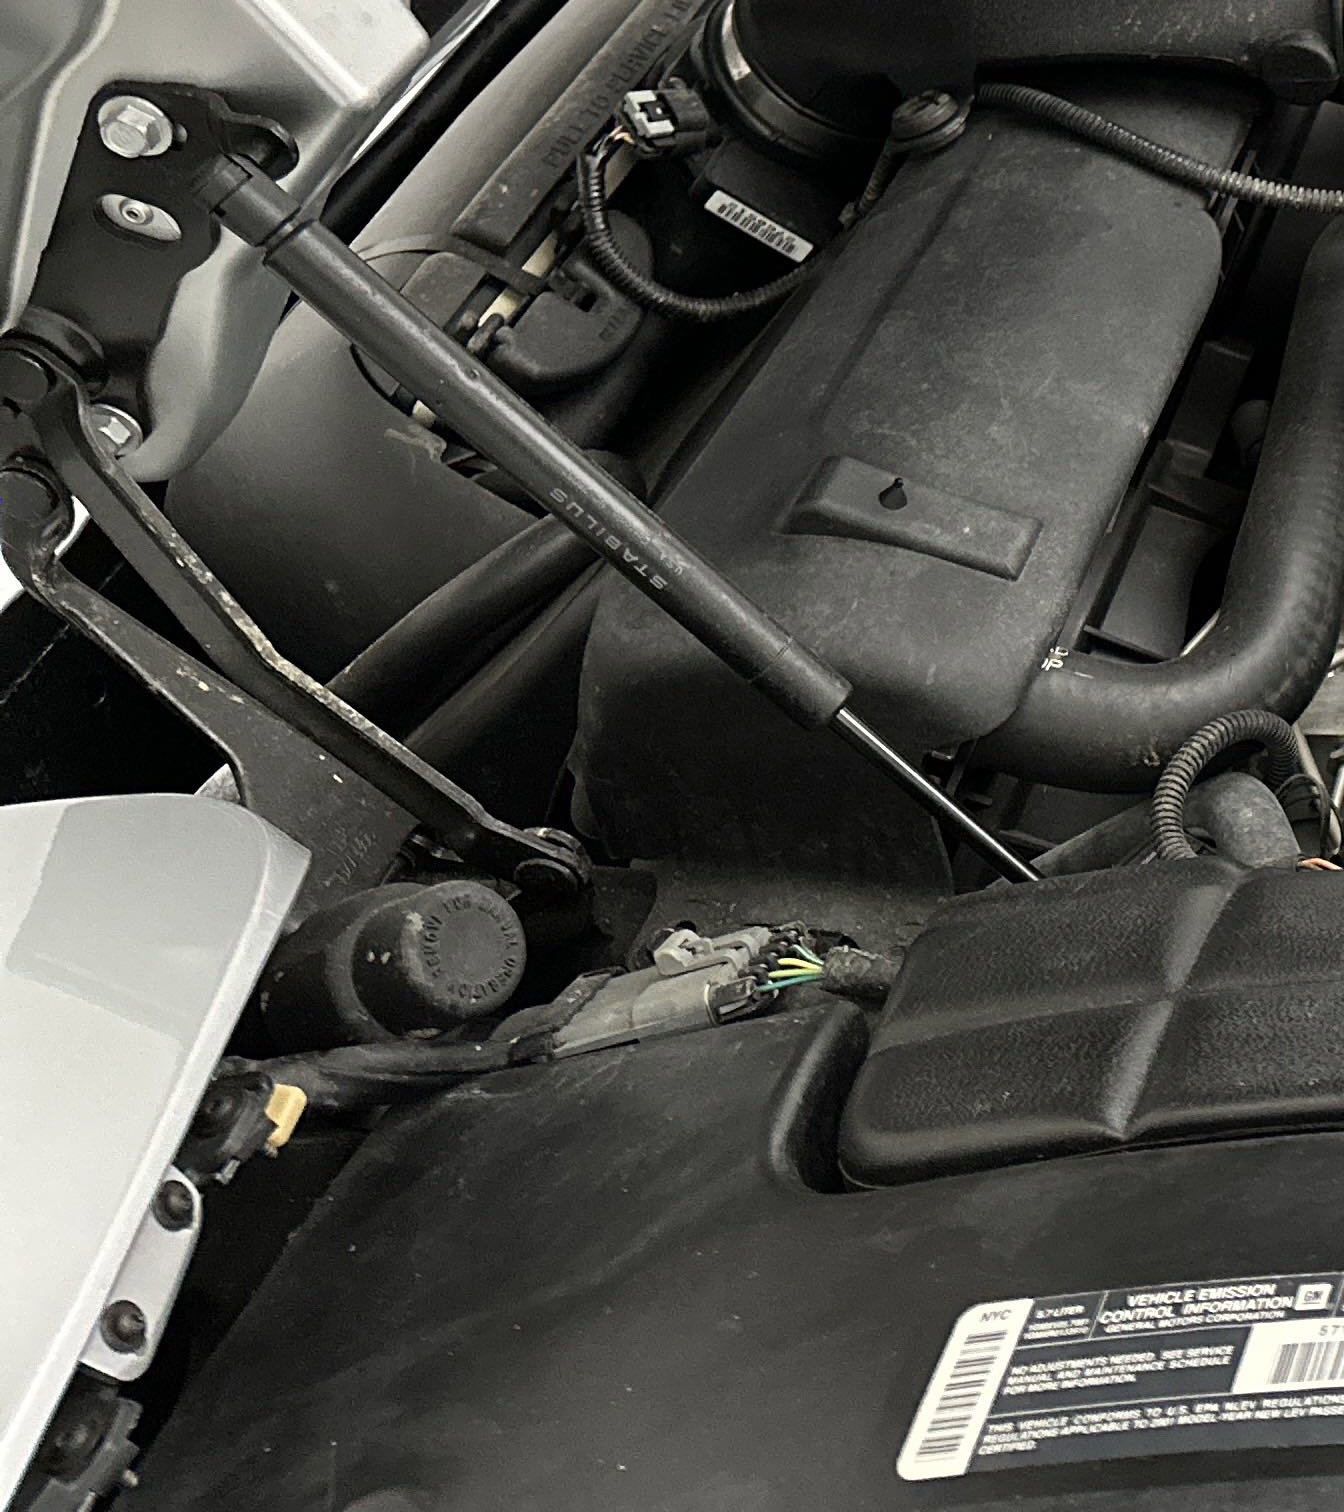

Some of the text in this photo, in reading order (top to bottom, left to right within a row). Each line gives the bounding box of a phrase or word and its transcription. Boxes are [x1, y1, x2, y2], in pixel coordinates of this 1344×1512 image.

[549, 487, 669, 590] STABILUS
[1127, 1284, 1277, 1307] VEHICLE EMISSION
[1303, 1290, 1323, 1302] GM
[980, 1308, 1012, 1322] NYC
[1100, 1306, 1176, 1324] CONTROL
[1182, 1296, 1295, 1315] INFORMATION
[1104, 1321, 1156, 1334] GENERAL
[1158, 1317, 1204, 1328] MOTORS
[1205, 1311, 1286, 1323] CORPORATION
[1011, 1365, 1029, 1376] NO
[1029, 1356, 1109, 1373] ADJUSTMENTS
[1184, 1345, 1235, 1358] SERVICE
[1057, 1369, 1083, 1380] AND
[1084, 1361, 1166, 1377] MAINTENANCE
[1169, 1355, 1231, 1369] SCHEDULE
[988, 1422, 1014, 1434] THIS
[1019, 1416, 1069, 1430] VEHICLE
[1073, 1409, 1141, 1426] CONFORMS
[1147, 1407, 1163, 1418] TO
